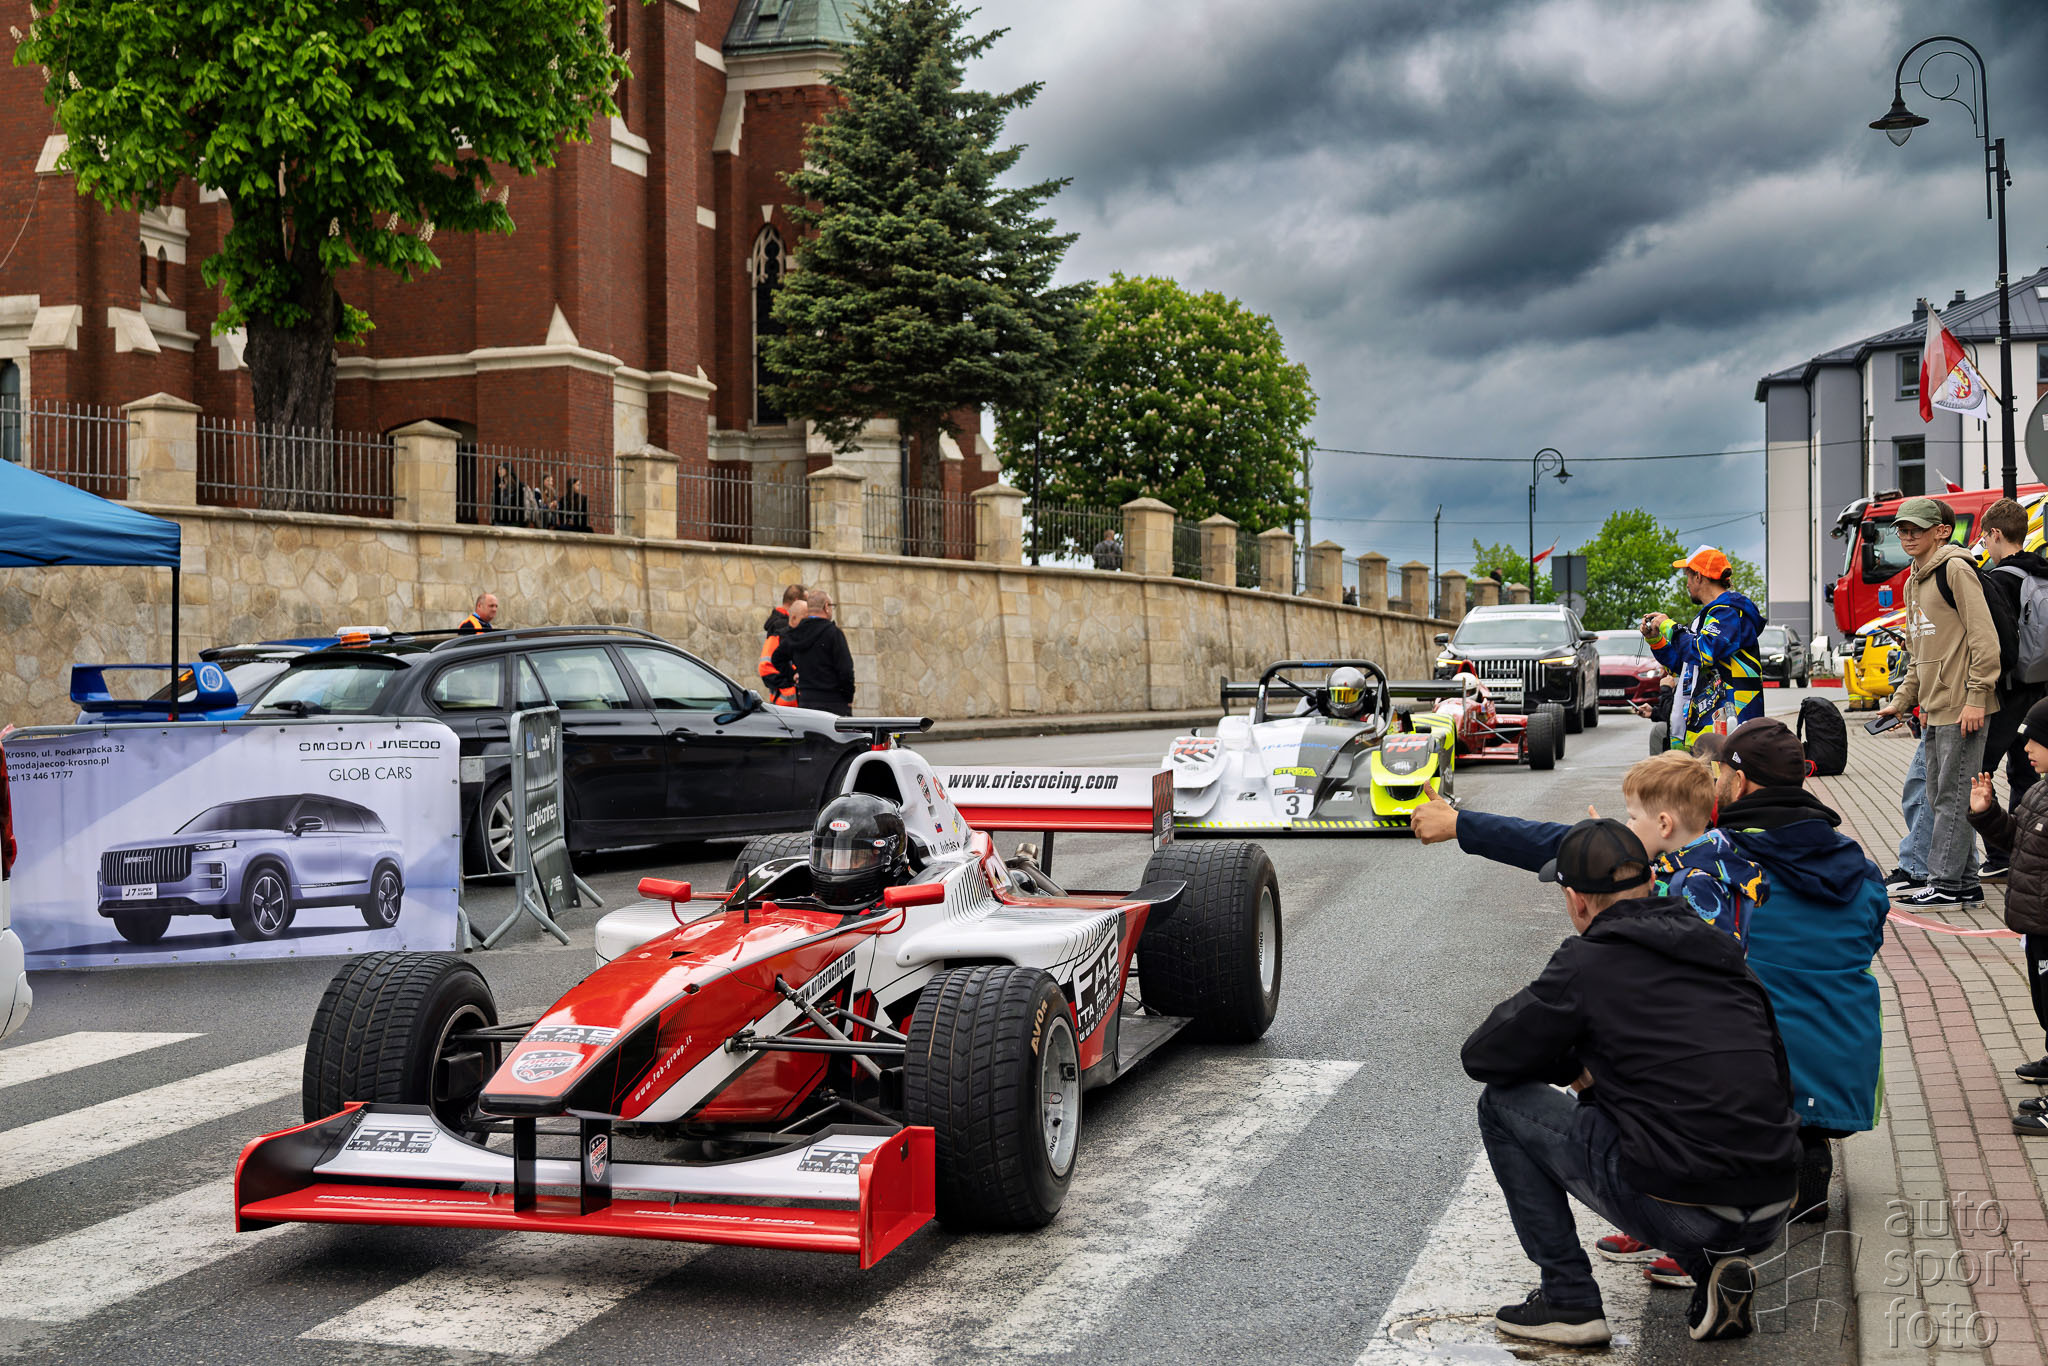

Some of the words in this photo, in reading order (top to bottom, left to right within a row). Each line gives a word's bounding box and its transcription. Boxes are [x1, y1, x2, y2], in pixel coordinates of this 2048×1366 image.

[5, 750, 39, 759] Krosno,
[41, 748, 53, 757] ul.
[55, 745, 112, 757] Podkarpacka
[114, 744, 125, 753] 32
[299, 741, 366, 752] OMODA
[377, 740, 441, 750] JAECOO
[6, 757, 110, 771] omodajaecoo-krosno.pl
[21, 773, 31, 781] 13
[33, 771, 49, 780] 446
[50, 771, 61, 779] 17
[63, 770, 73, 778] 77
[329, 768, 370, 781] GLOB
[374, 766, 412, 780] CARS
[1273, 767, 1317, 777] STREFA
[948, 770, 1119, 794] www.ariesracing.com
[1285, 795, 1300, 815] 3
[1073, 922, 1119, 1011] FAB
[1078, 1003, 1095, 1028] ITA
[1096, 982, 1108, 1008] FAB
[529, 1025, 622, 1039] FAB
[518, 1062, 573, 1070] RACING
[523, 1055, 577, 1066] ARIES
[635, 1035, 692, 1102] www.fab-group.it
[353, 1125, 440, 1142] FAB
[804, 1146, 864, 1164] FA
[800, 1160, 824, 1168] ITA
[830, 1162, 856, 1170] FAB
[317, 1194, 428, 1204] motorsport
[429, 1198, 488, 1206] media
[633, 1209, 751, 1222] motorsport
[753, 1216, 816, 1226] media
